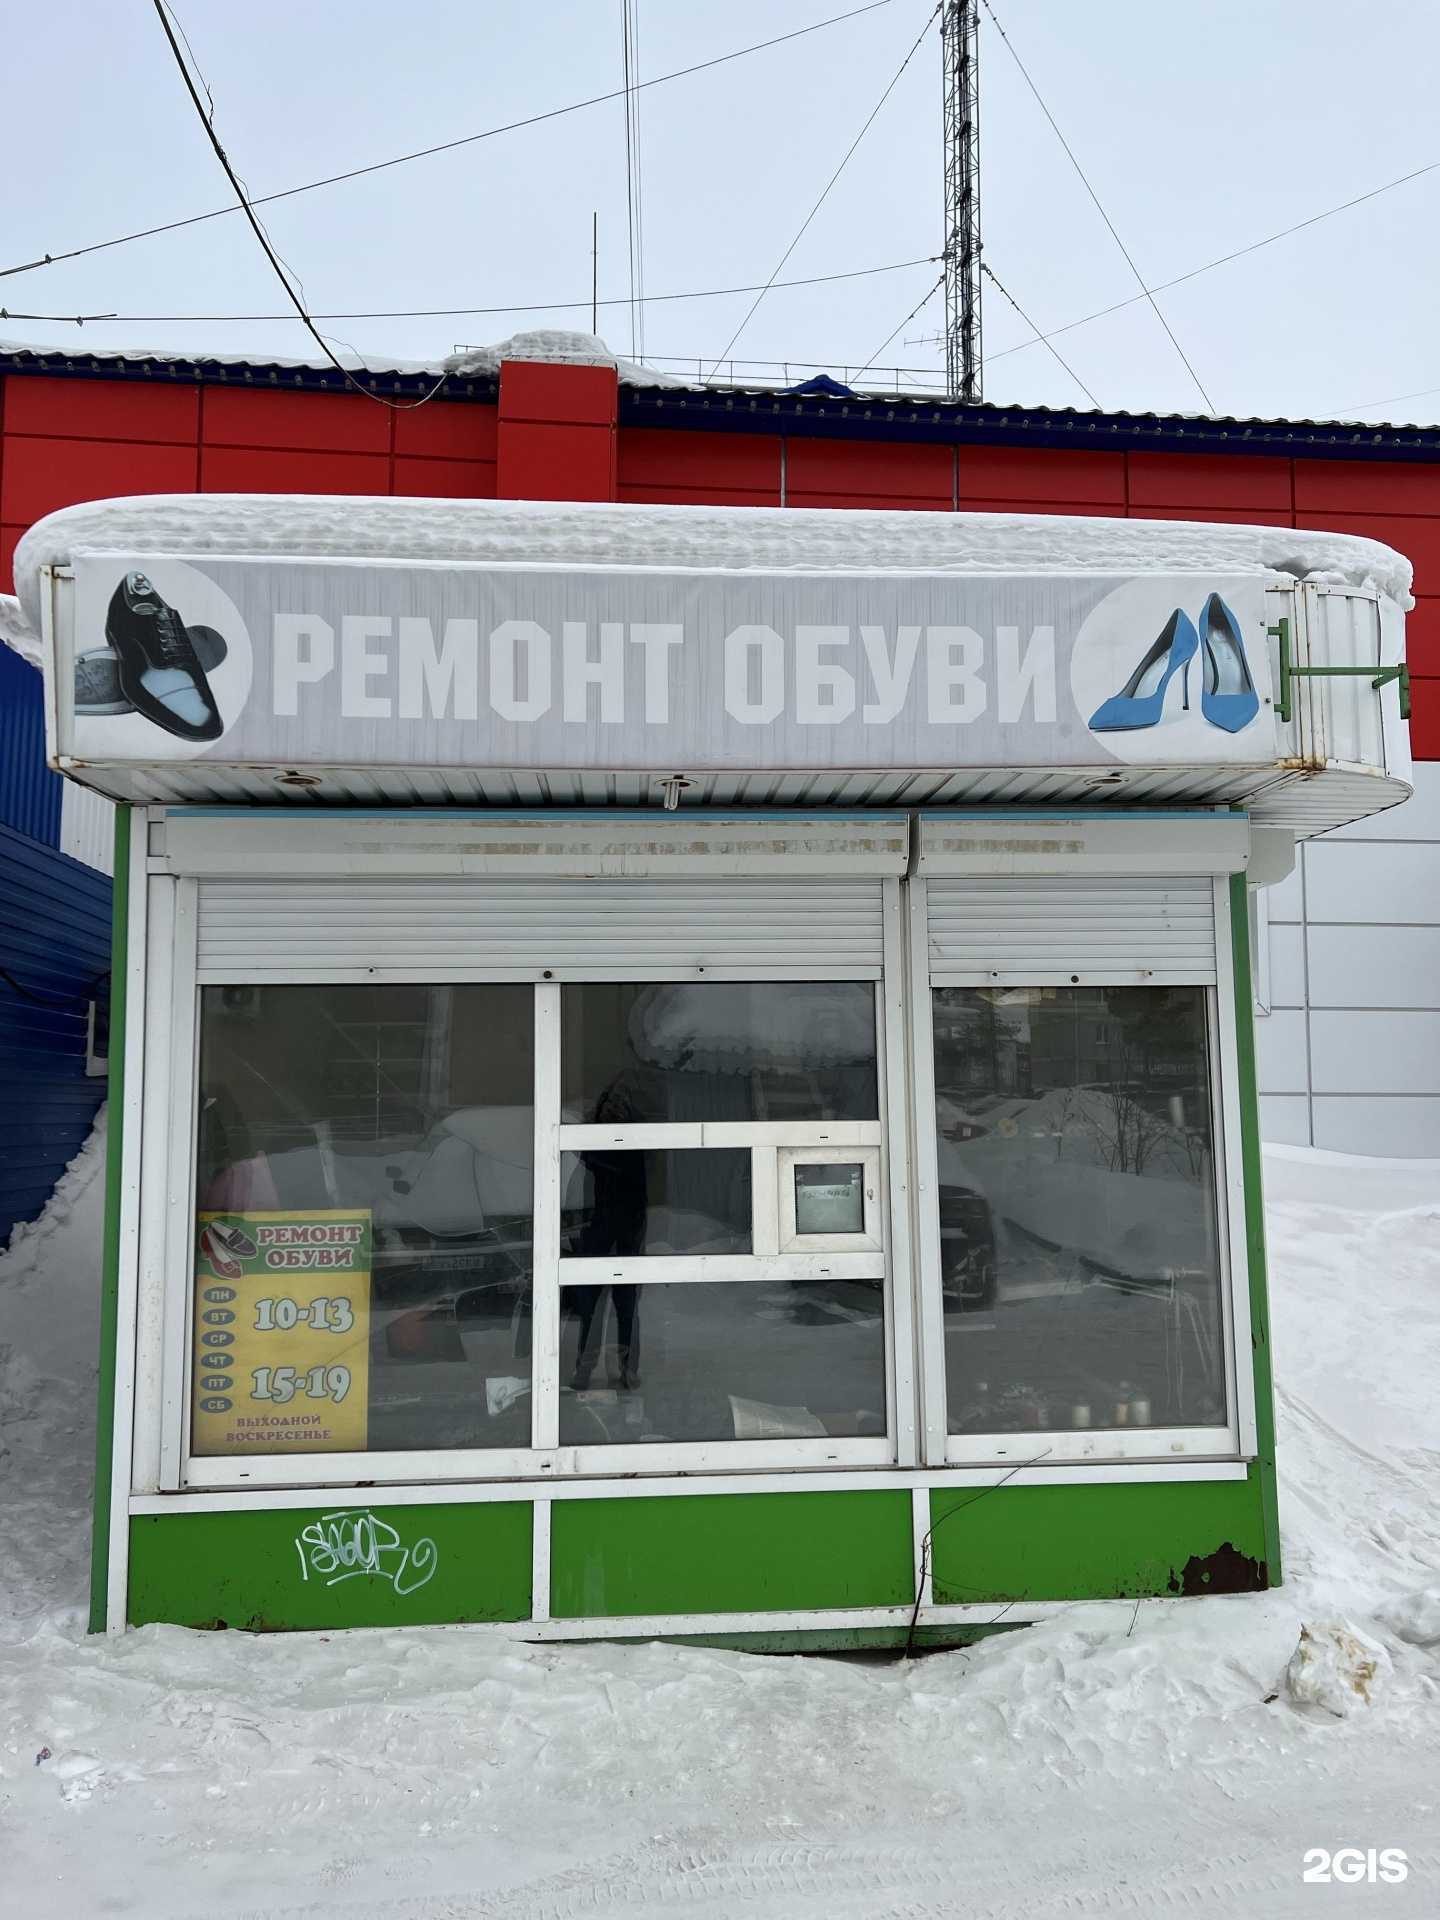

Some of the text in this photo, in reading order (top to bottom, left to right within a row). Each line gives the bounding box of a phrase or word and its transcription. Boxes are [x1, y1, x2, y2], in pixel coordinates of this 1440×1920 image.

[272, 612, 1057, 726] РЕМОНТ ОБУВИ
[256, 1224, 363, 1245] РЕМОНТ
[265, 1248, 354, 1268] ОБУВИ
[210, 1290, 231, 1301] ПН
[210, 1311, 228, 1322] ВТ
[253, 1297, 354, 1334] 10-13
[209, 1333, 228, 1344] СР
[208, 1355, 227, 1366] ЧТ
[207, 1377, 226, 1389] ПТ
[250, 1366, 351, 1403] 15-19
[207, 1399, 226, 1410] СБ
[236, 1415, 322, 1428] ВЫХОДНОЙ
[226, 1430, 332, 1442] ВОСКРЕСЕНЬЕ
